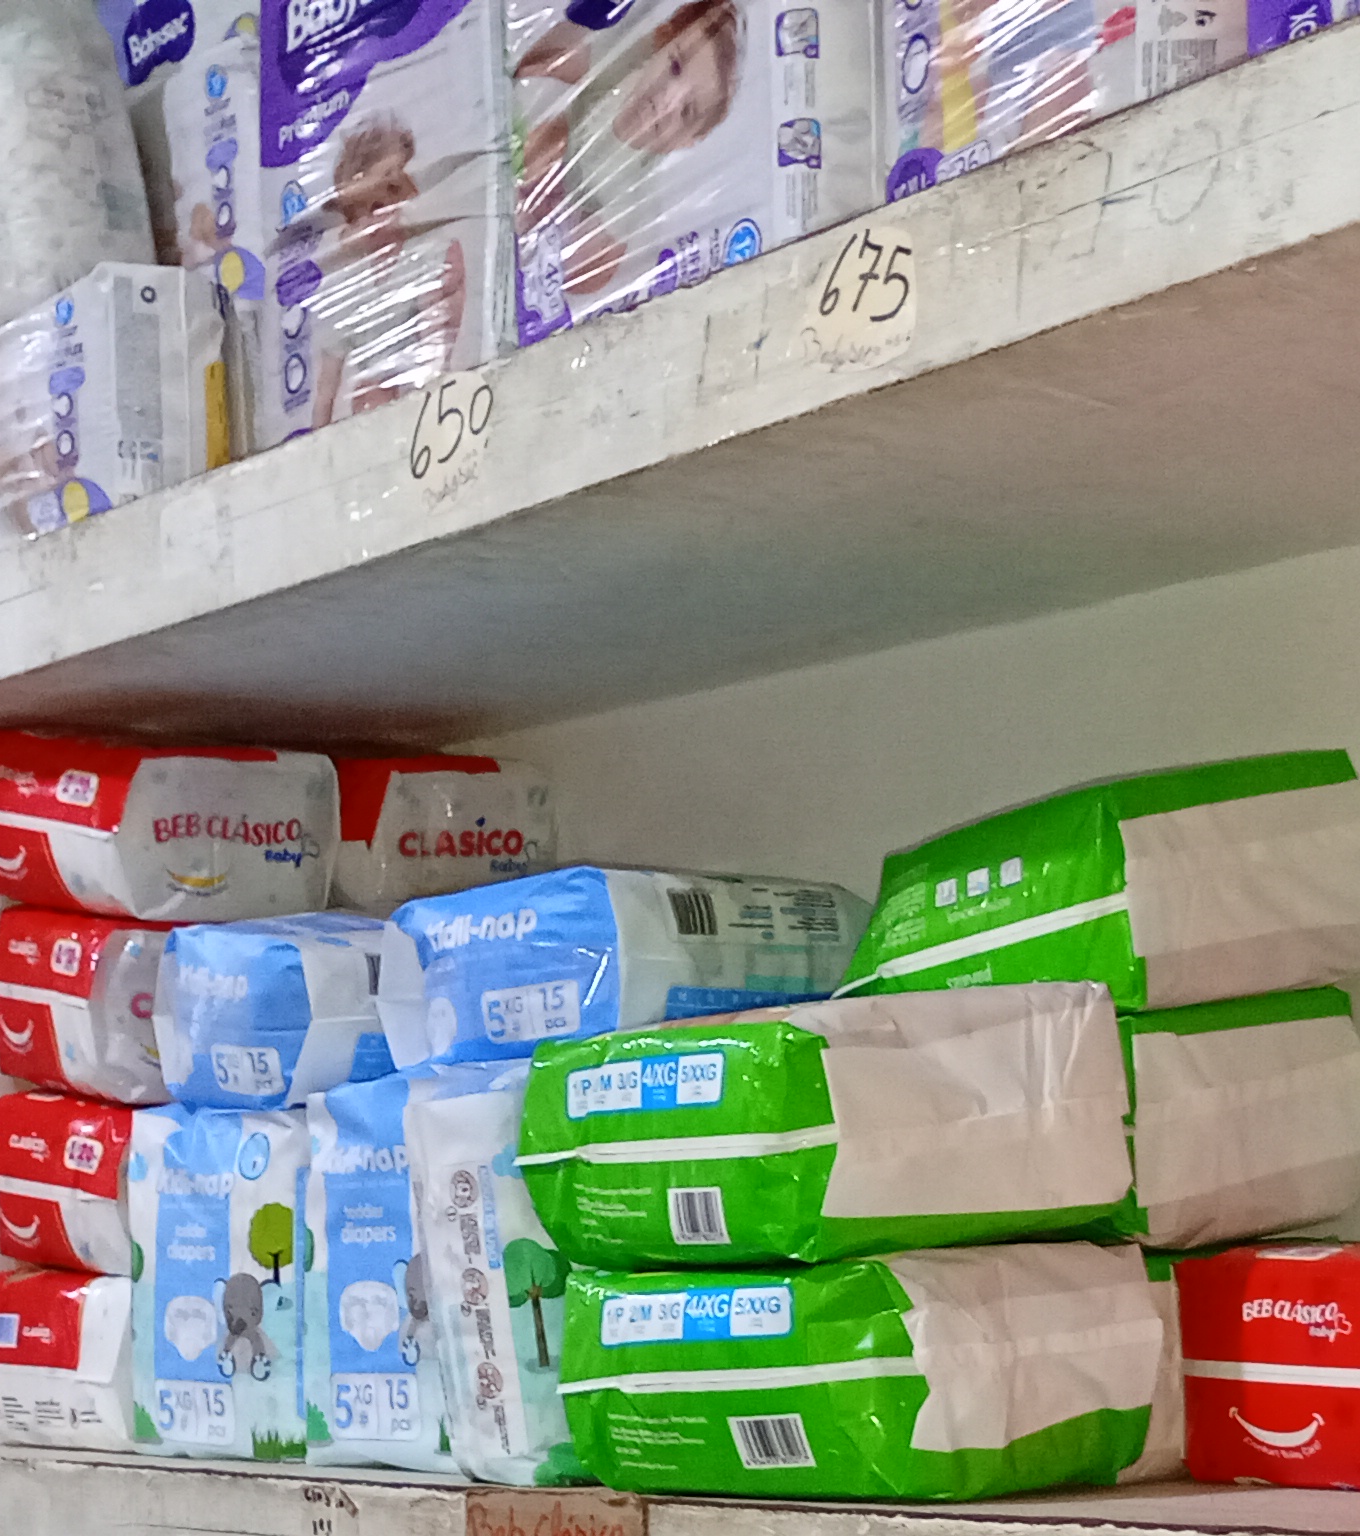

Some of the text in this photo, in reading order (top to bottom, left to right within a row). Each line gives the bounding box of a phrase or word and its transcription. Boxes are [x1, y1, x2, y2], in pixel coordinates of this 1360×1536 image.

[819, 228, 912, 323] 675
[411, 379, 494, 479] 650
[153, 812, 204, 844] BEB
[264, 849, 303, 868] Baby
[487, 999, 505, 1039] 5
[540, 984, 565, 1013] 15
[246, 1050, 270, 1076] 15
[1242, 1298, 1273, 1322] BEB
[159, 1388, 174, 1431] 5
[202, 1387, 226, 1417] 15
[335, 1383, 353, 1429] 5
[385, 1378, 409, 1411] 15
